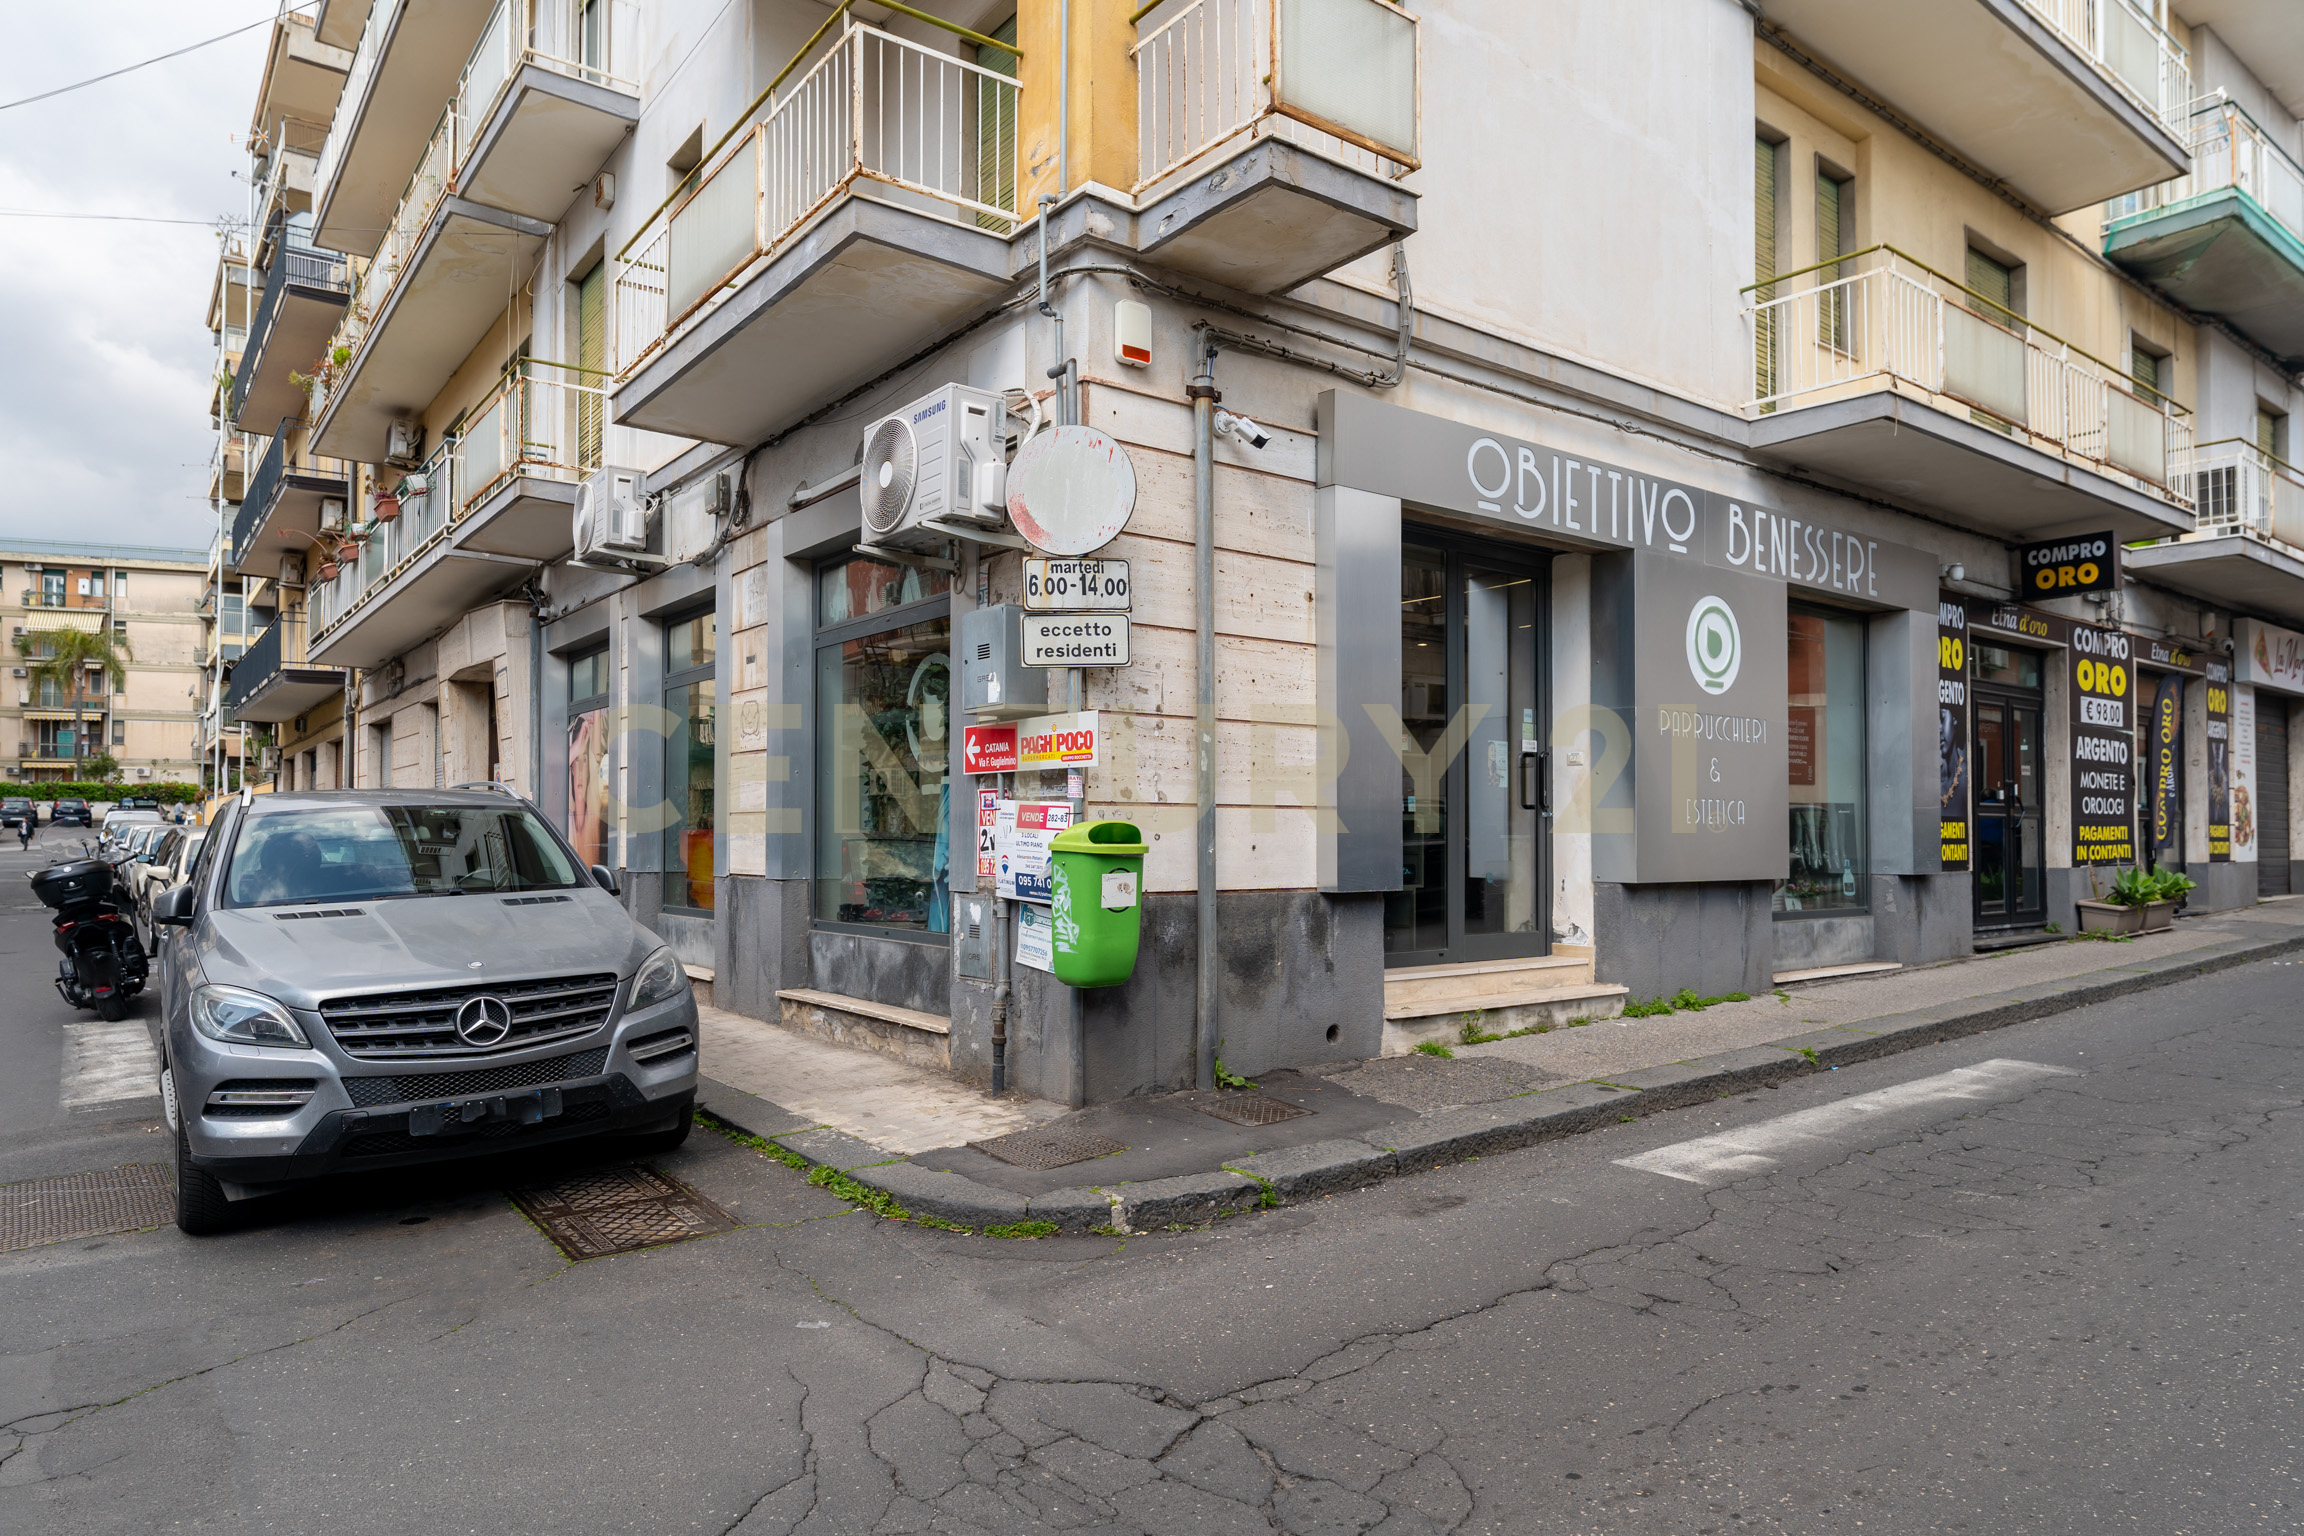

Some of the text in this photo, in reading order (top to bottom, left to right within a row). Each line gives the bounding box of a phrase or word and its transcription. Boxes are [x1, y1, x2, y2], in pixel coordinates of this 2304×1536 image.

[913, 399, 946, 425] SAMSUNG
[1467, 437, 1879, 597] OBIETTIVO BENESSERE
[2027, 540, 2106, 566] COMPRO
[2035, 562, 2099, 590] ORO
[1938, 602, 1965, 630] MPRO
[1991, 608, 2048, 636] Etna d'oro
[1040, 622, 1112, 637] eccetto
[1036, 642, 1117, 658] residenti
[1938, 636, 1963, 671] RO
[2073, 627, 2128, 660] COMPRO
[2151, 642, 2169, 662] Etna
[2077, 659, 2126, 697] ORO
[2207, 687, 2227, 714] ORO
[1660, 709, 1767, 744] PARRUCCHIERI
[2160, 698, 2174, 744] ORO
[984, 742, 1010, 753] CATANIA
[1021, 753, 1056, 762] SUPERMERCATI
[2075, 736, 2128, 764] ARGENTO
[990, 756, 1017, 768] Guglielmino
[1710, 757, 1721, 782] &
[2080, 771, 2126, 790] MONETE E
[1021, 811, 1045, 822] VENDE
[1686, 799, 1745, 825] ESTETICA
[2082, 796, 2124, 815] OROLOGI
[1015, 840, 1044, 849] ULTIMO PIANO
[2079, 826, 2128, 841] PAGAMENTI
[2076, 844, 2132, 861] IN CONTANTI
[1018, 875, 1032, 887] 095
[1033, 876, 1046, 889] 741
